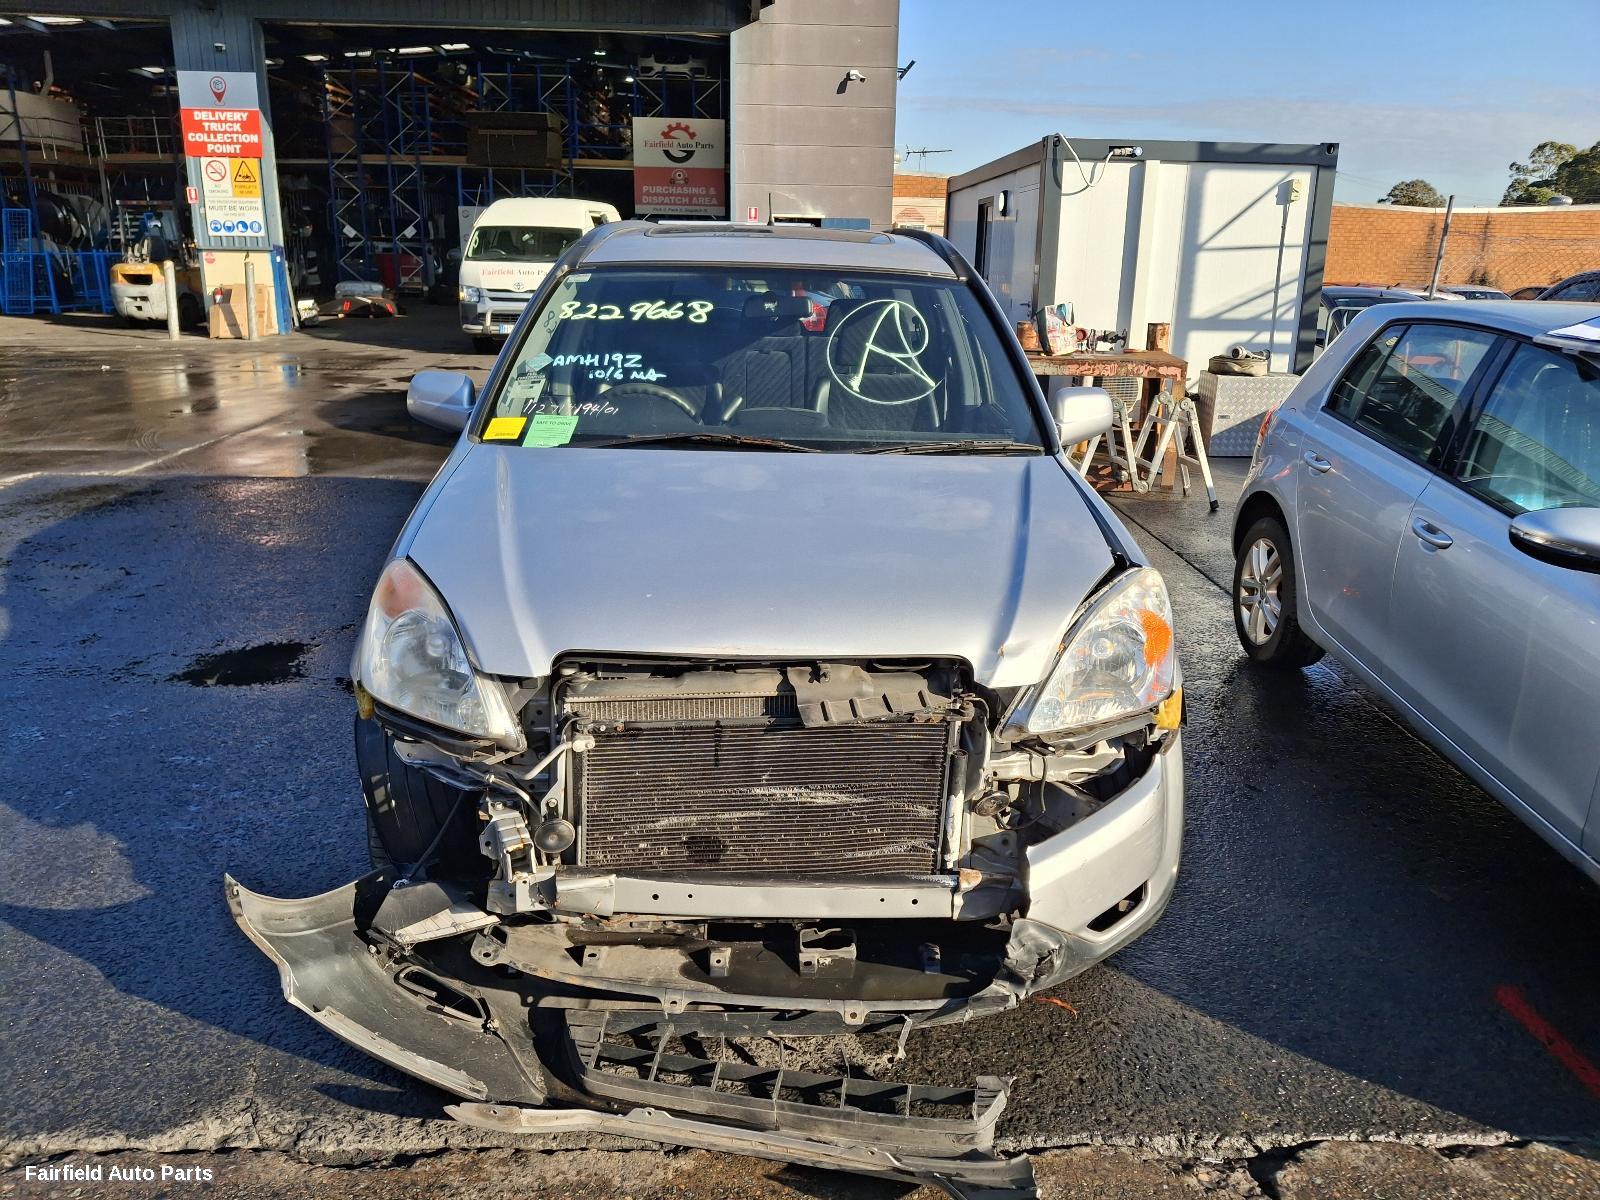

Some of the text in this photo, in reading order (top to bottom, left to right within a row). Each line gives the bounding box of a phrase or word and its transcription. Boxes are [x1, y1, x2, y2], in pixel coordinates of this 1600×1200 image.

[193, 111, 249, 121] DELIVERY
[202, 122, 242, 132] TRUCK
[187, 132, 259, 144] COLLECTION
[207, 143, 242, 154] POINT
[644, 140, 715, 150] Fairfield Auto Parts
[642, 185, 706, 195] PURCHASING
[641, 195, 718, 205] DISPATCH AREA
[482, 268, 514, 276] Fairfield
[558, 300, 714, 323] 8229668
